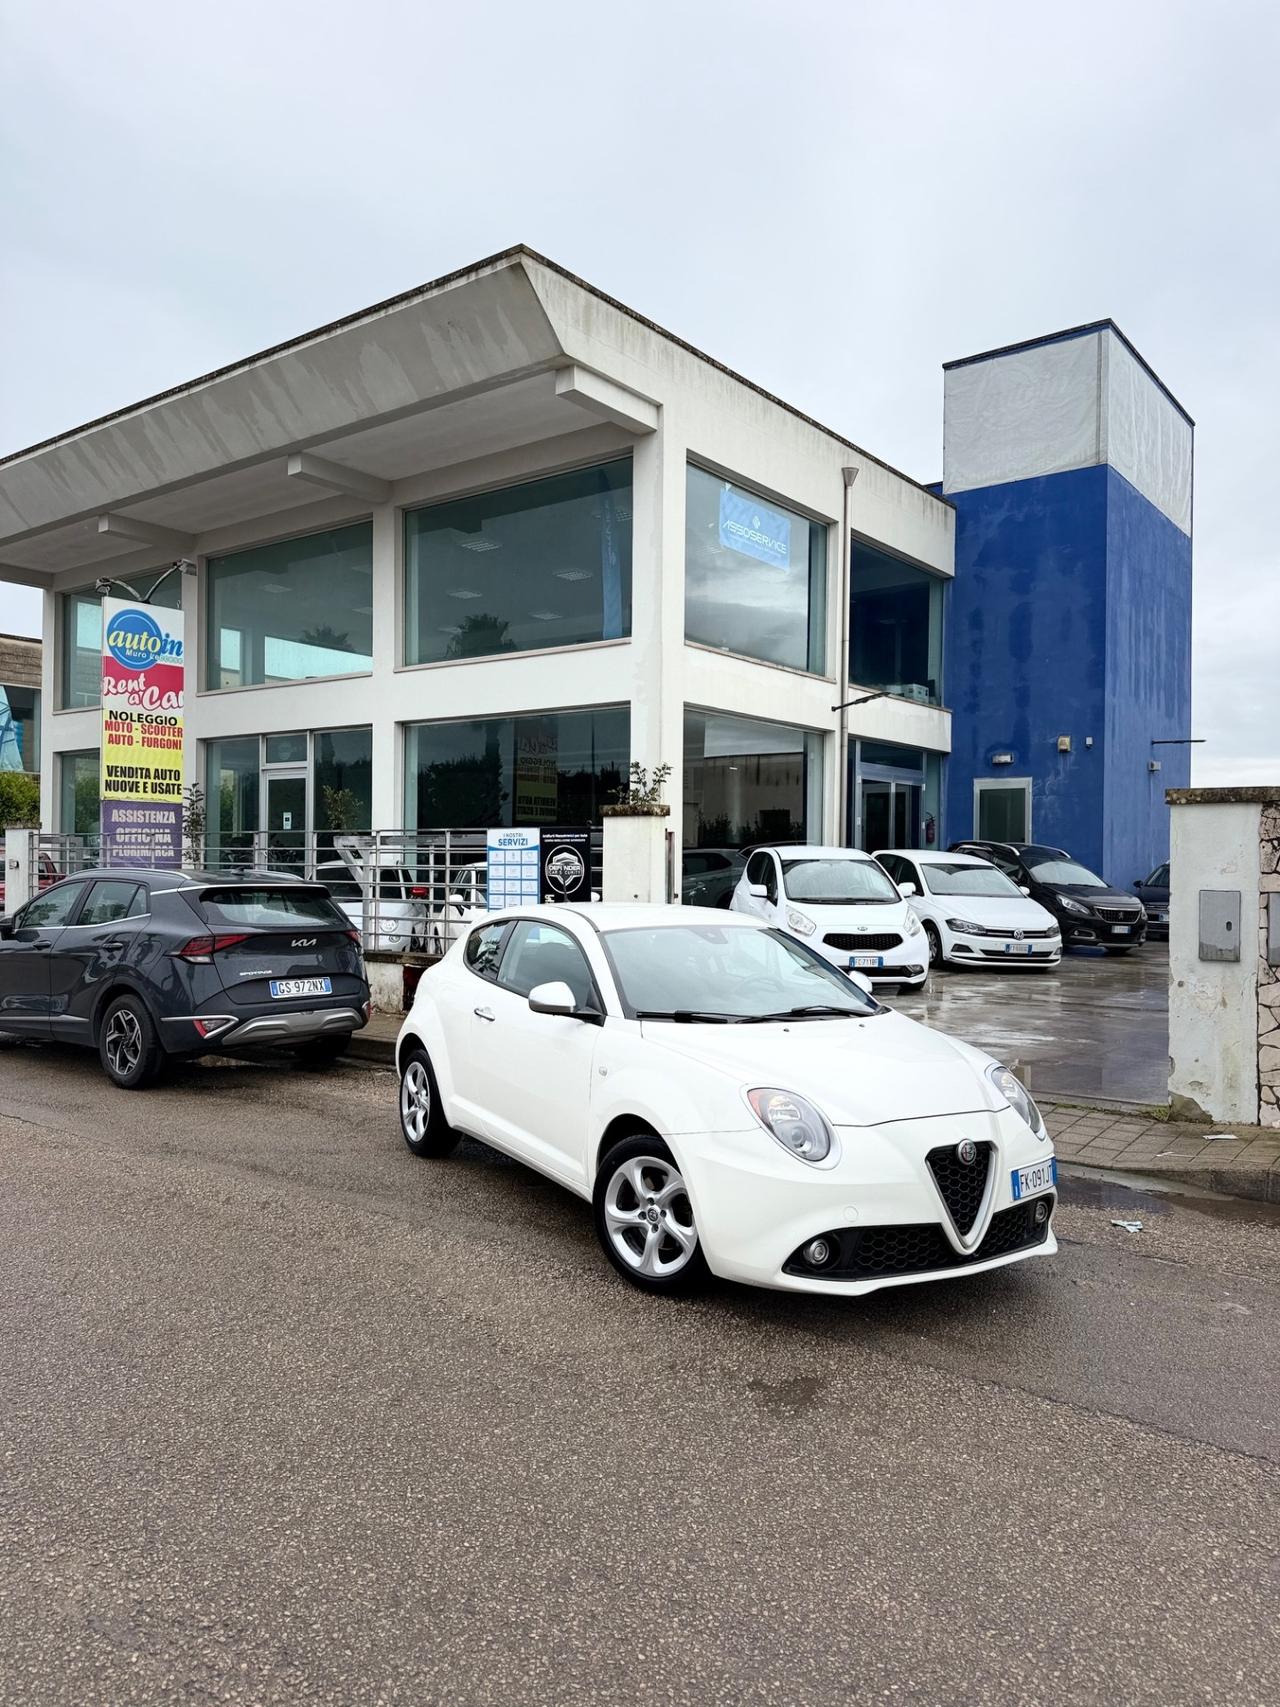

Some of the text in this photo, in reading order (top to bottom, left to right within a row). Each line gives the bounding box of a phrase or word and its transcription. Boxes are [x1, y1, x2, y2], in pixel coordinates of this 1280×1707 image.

[723, 519, 787, 554] ASSOSERVICE
[126, 649, 147, 659] Muro
[103, 672, 146, 695] Rent
[109, 710, 178, 726] NOLEGGIO
[105, 720, 133, 733] MOTO
[141, 723, 184, 738] SCOOTER
[107, 733, 134, 746] AUTO
[141, 736, 182, 750] FURGONI
[106, 765, 180, 781] VENDITA AUTO
[105, 779, 182, 795] NUOVE E USATE
[111, 809, 176, 824] ASSISTENZA
[498, 838, 528, 847] SERVIZI
[278, 980, 325, 994] GS 972NX
[1020, 1172, 1031, 1193] FK
